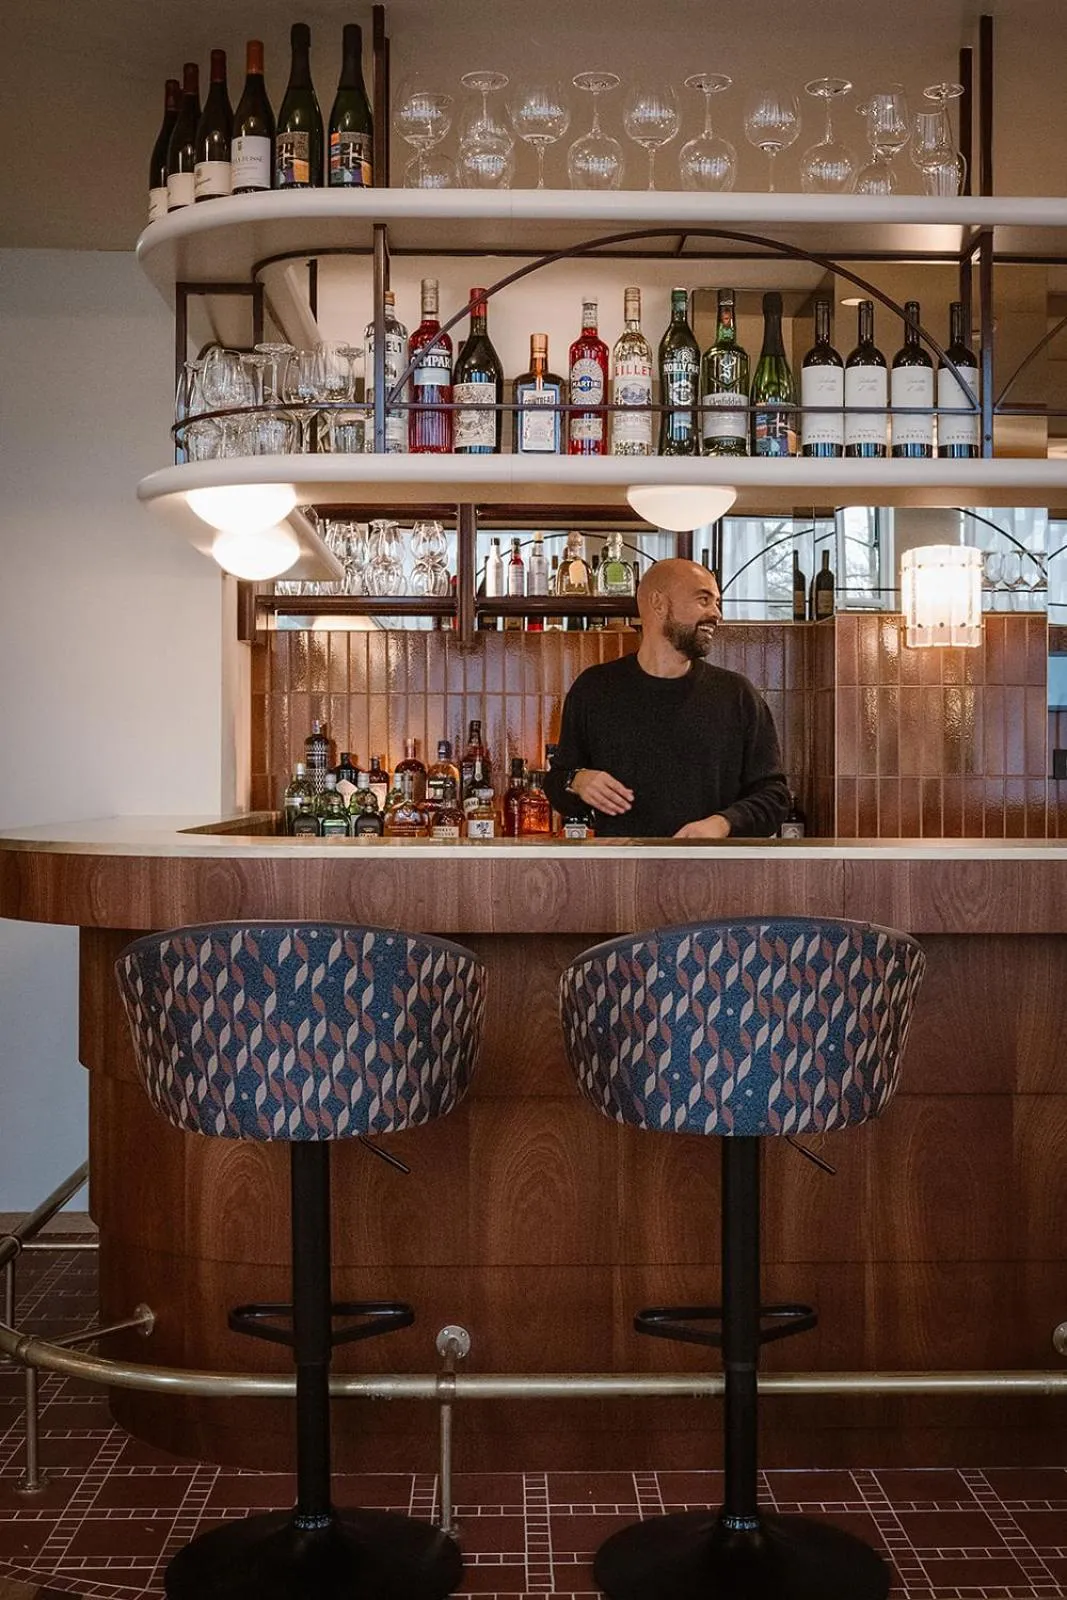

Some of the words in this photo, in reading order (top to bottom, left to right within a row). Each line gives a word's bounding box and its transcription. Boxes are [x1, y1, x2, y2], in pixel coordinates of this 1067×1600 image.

[410, 355, 452, 368] CMPAR
[663, 362, 687, 373] NOILLY
[615, 365, 654, 377] LILLET
